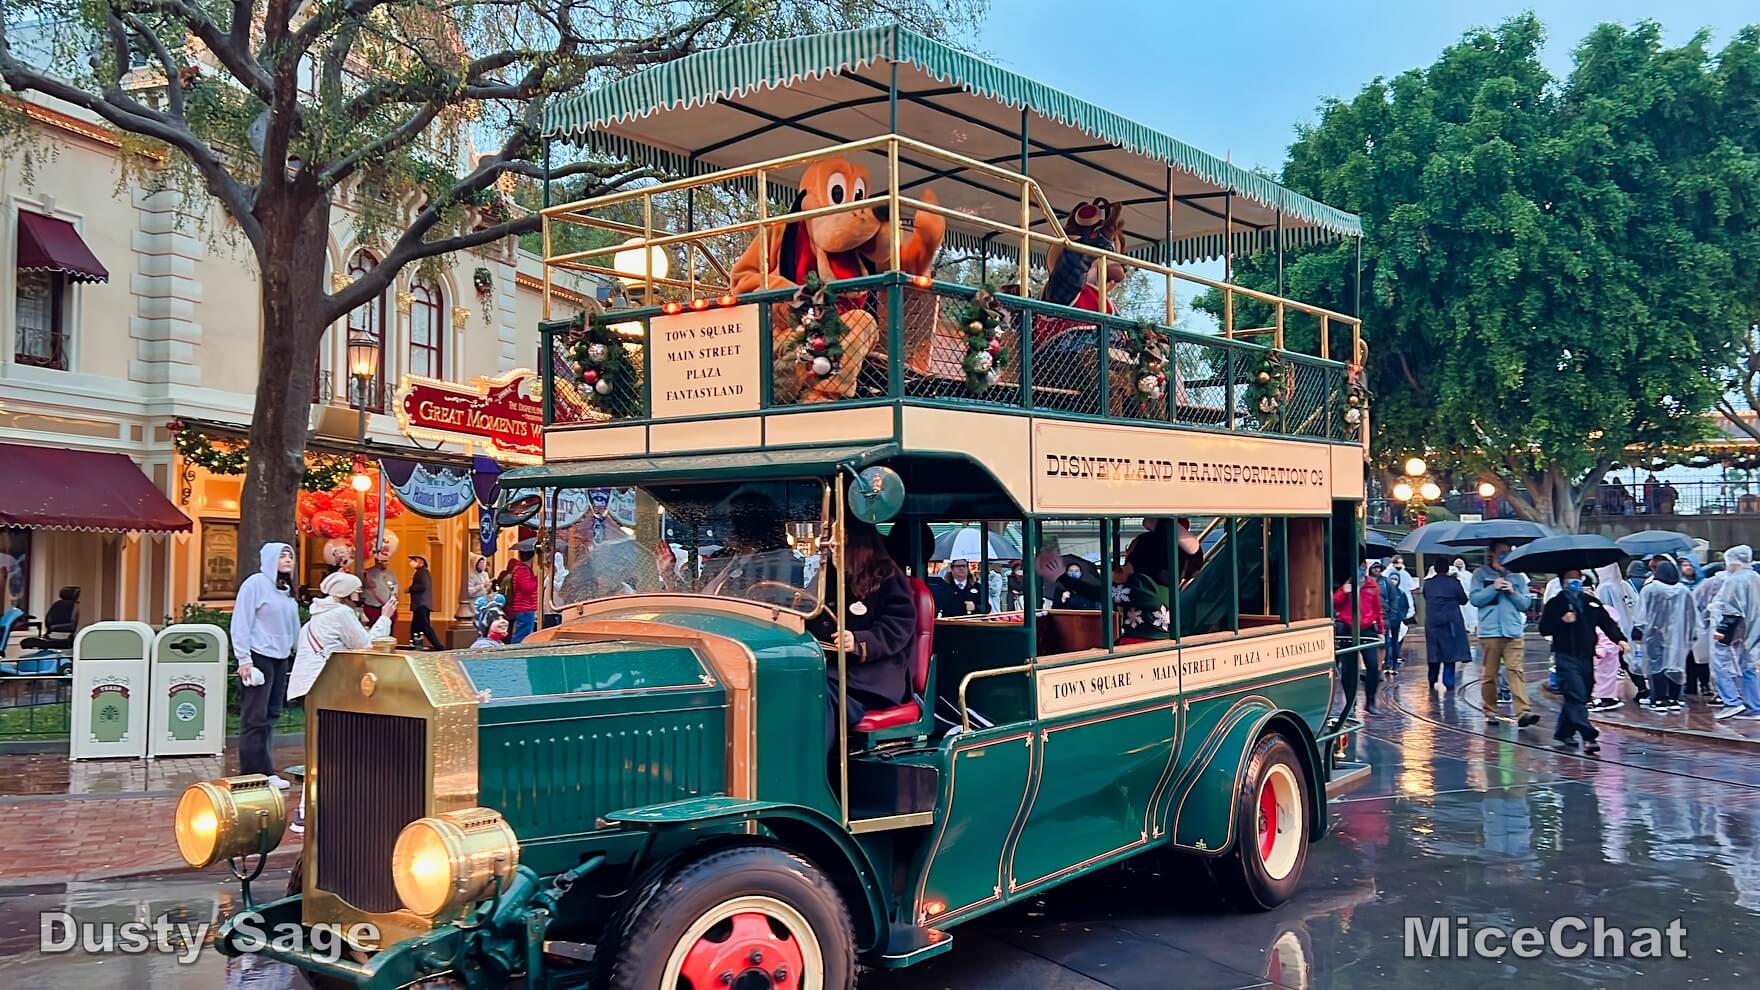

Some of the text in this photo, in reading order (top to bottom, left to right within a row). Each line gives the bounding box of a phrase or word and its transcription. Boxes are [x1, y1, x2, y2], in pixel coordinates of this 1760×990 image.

[665, 323, 743, 342] TOWN SQUARE
[667, 344, 741, 362] MAIN STREET
[687, 367, 721, 380] PLAZA
[666, 384, 744, 401] FANTASYLAND
[1046, 453, 1173, 481] DISNEYLAND
[1178, 460, 1309, 487] TRANSPORTATION
[1052, 640, 1326, 699] TOWN SQUARE MAIN STREET PLAZA FANTASYLAND
